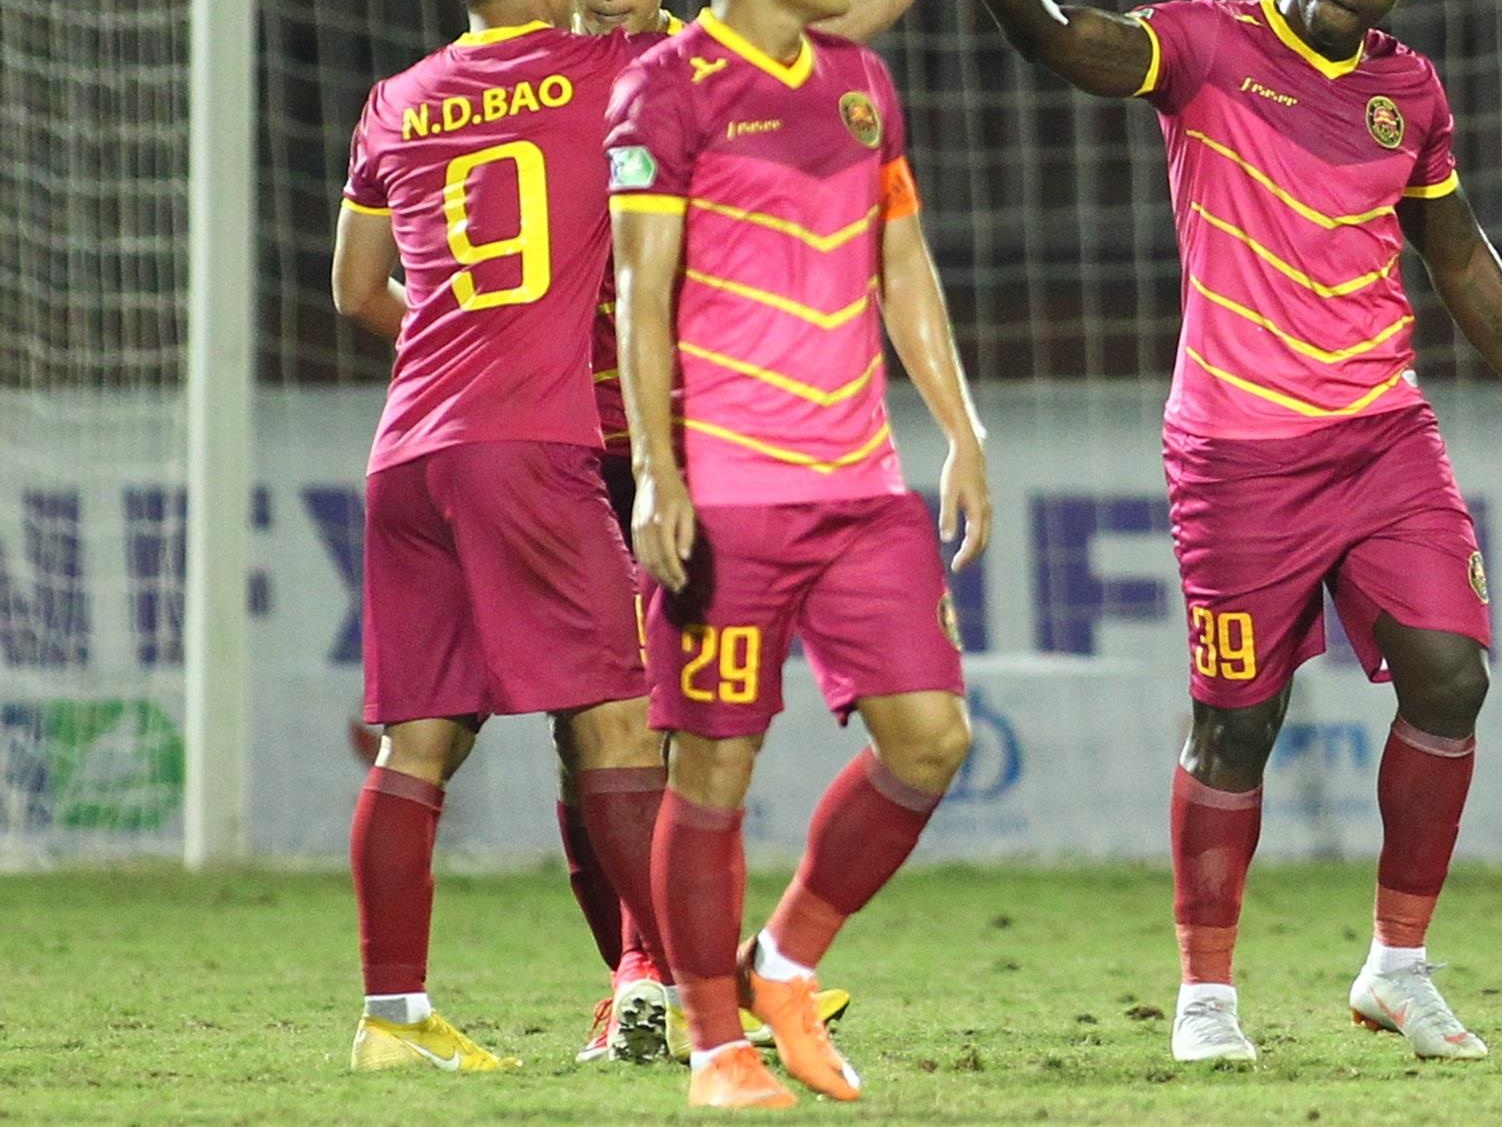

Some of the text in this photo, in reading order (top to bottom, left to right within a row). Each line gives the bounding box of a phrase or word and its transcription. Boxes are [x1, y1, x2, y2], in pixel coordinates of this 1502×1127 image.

[402, 75, 573, 140] N.D.BAO
[443, 140, 551, 312] 9
[681, 625, 760, 703] 29
[1192, 606, 1258, 681] 39
